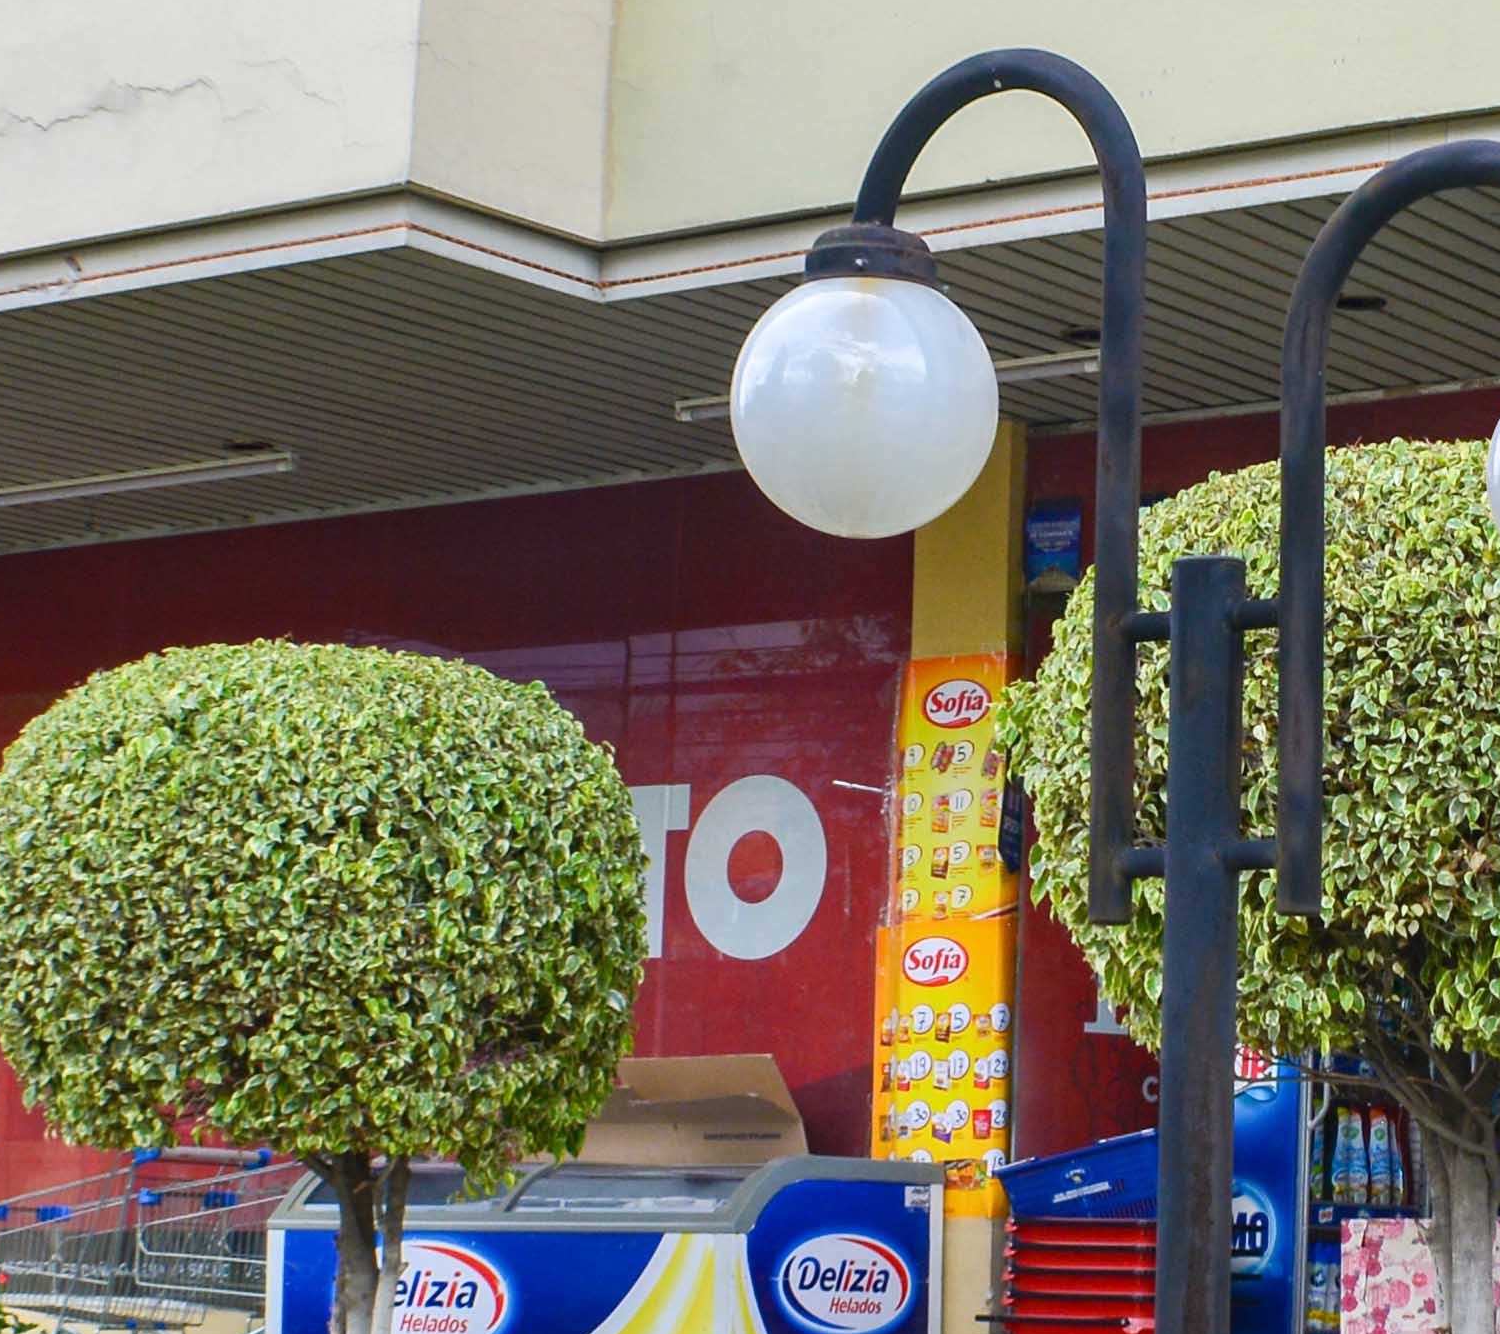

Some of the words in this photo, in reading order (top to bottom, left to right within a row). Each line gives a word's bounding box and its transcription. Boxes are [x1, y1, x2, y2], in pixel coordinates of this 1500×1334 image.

[929, 688, 985, 717] Sofía
[627, 774, 828, 961] TO
[908, 947, 962, 976] Sofía
[798, 1256, 890, 1293] Delizia
[393, 1270, 479, 1309] elizia
[829, 1296, 882, 1315] Helados
[399, 1313, 469, 1334] Helados
